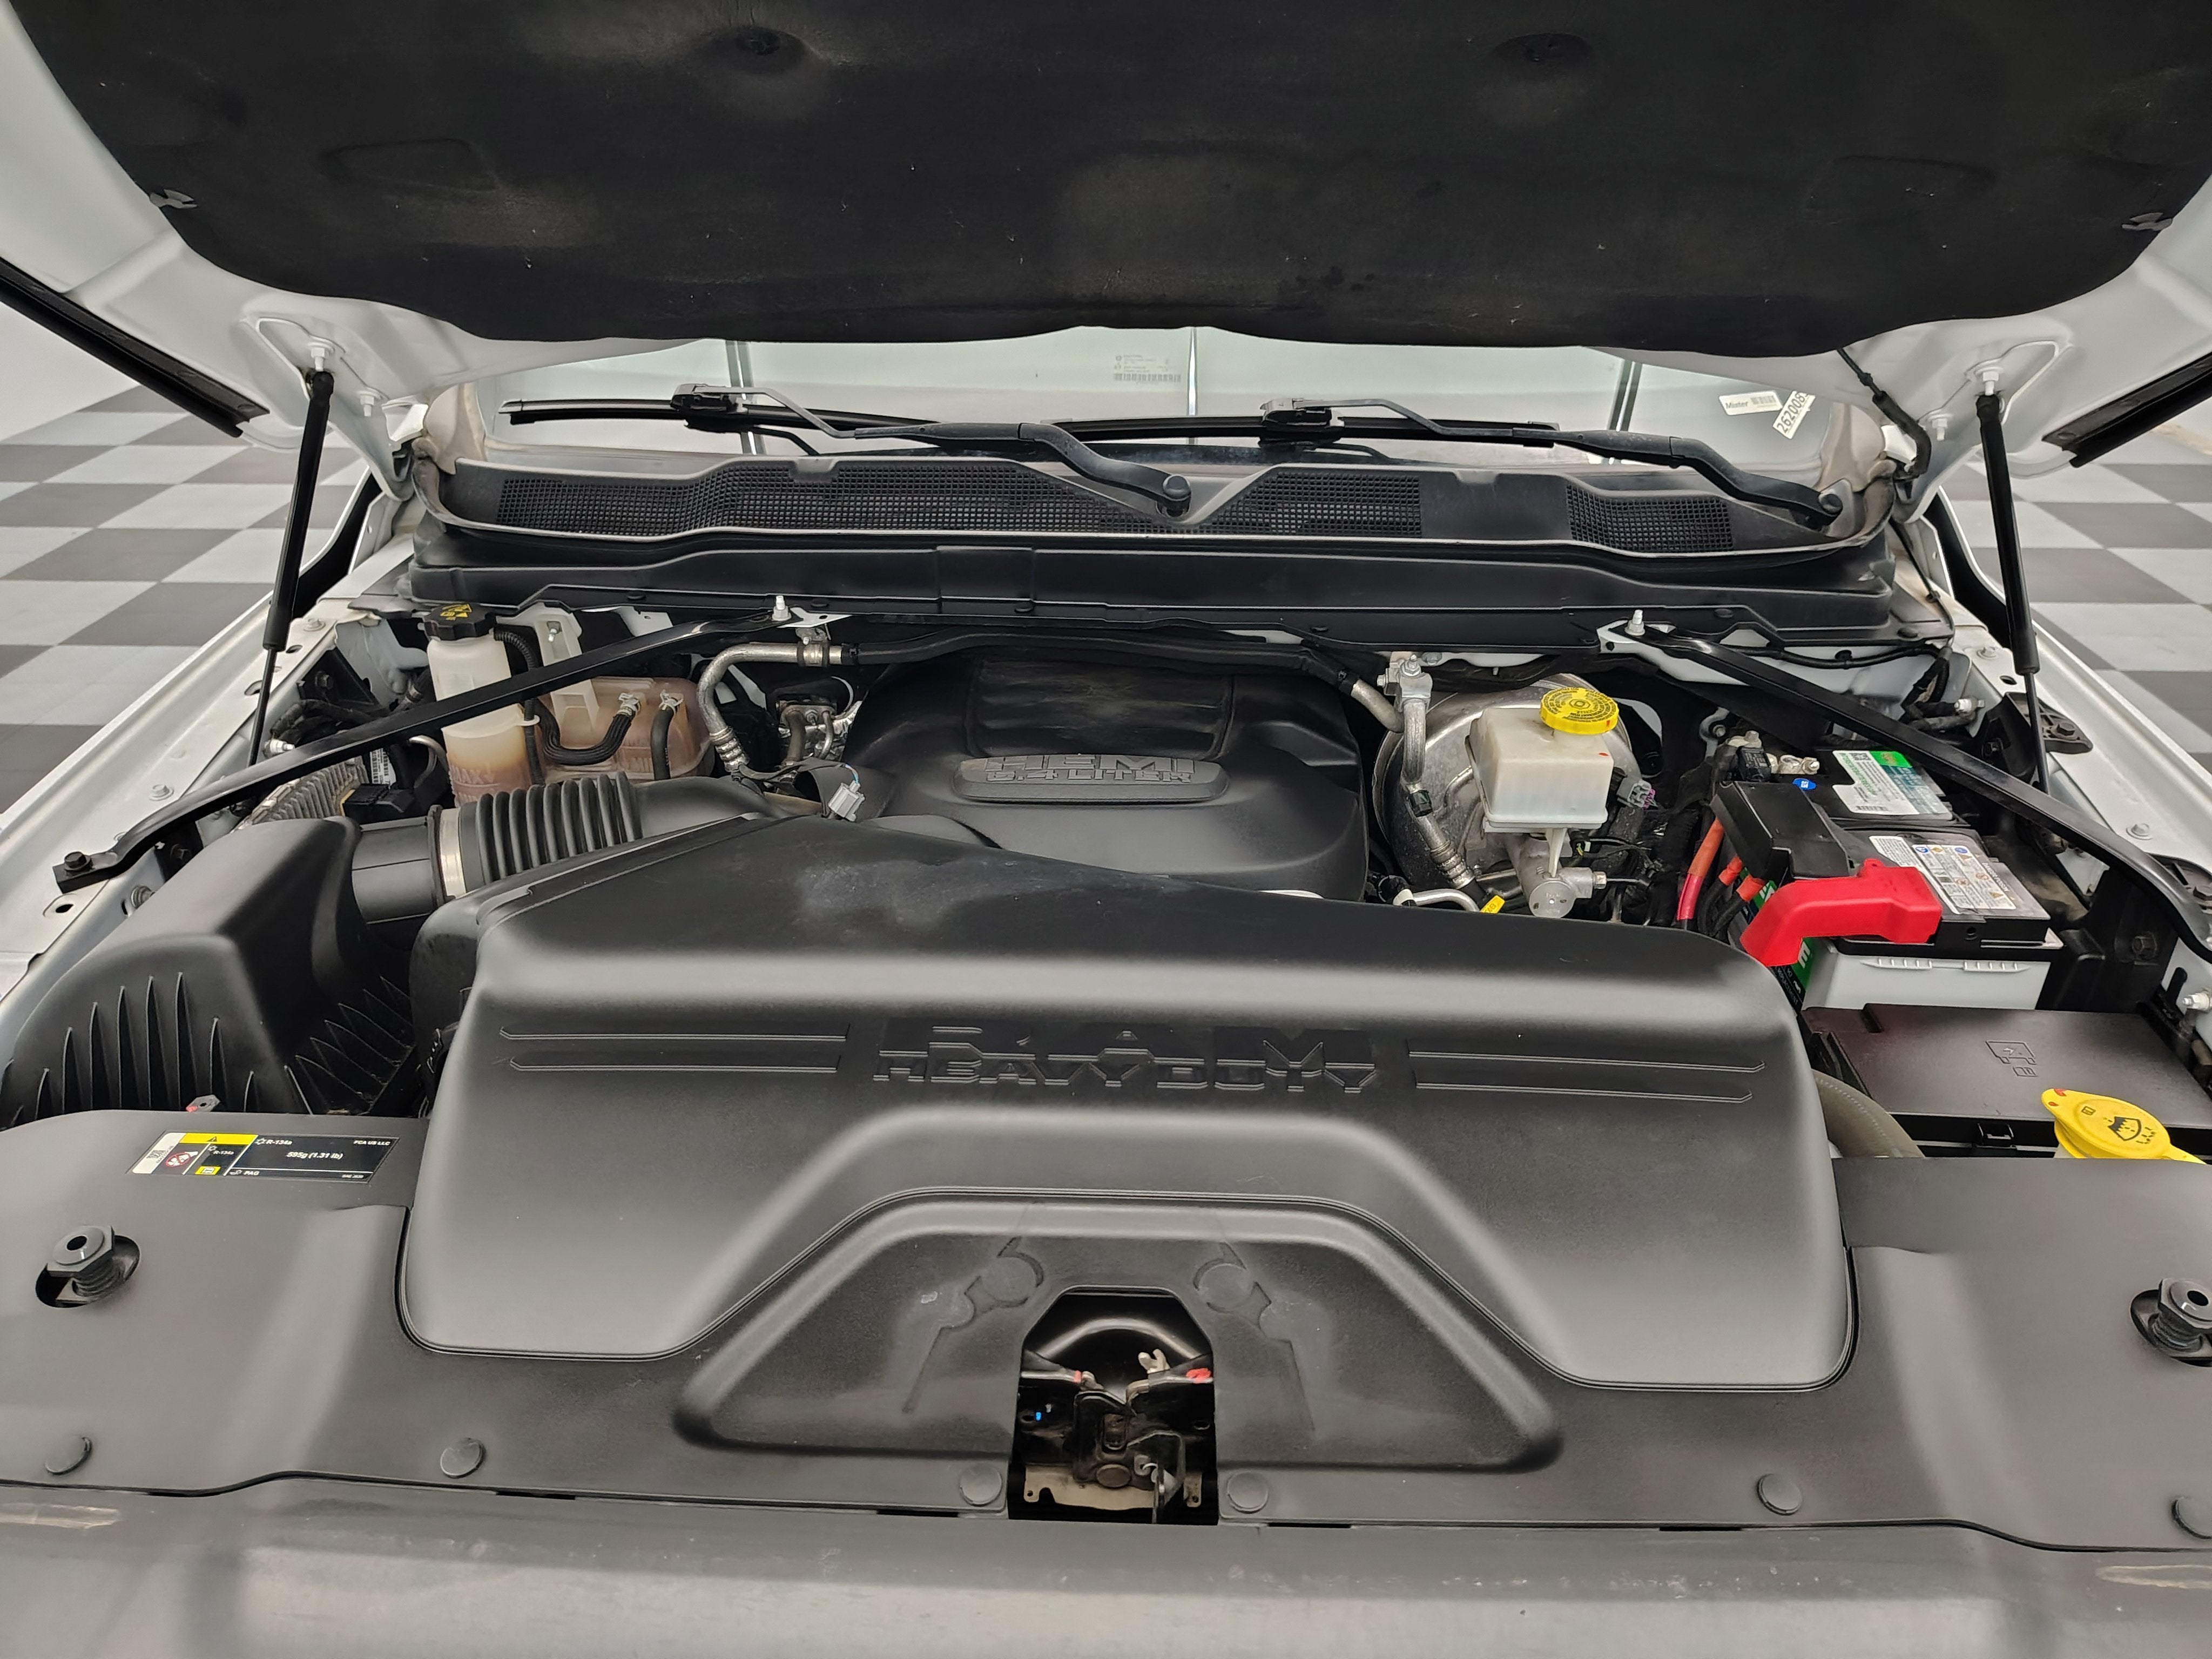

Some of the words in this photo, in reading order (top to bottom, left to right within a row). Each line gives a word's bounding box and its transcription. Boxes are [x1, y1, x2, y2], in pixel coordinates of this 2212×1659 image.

[1777, 392, 1808, 434] 262008
[984, 754, 1195, 773] HEMI
[1067, 764, 1192, 783] LITER
